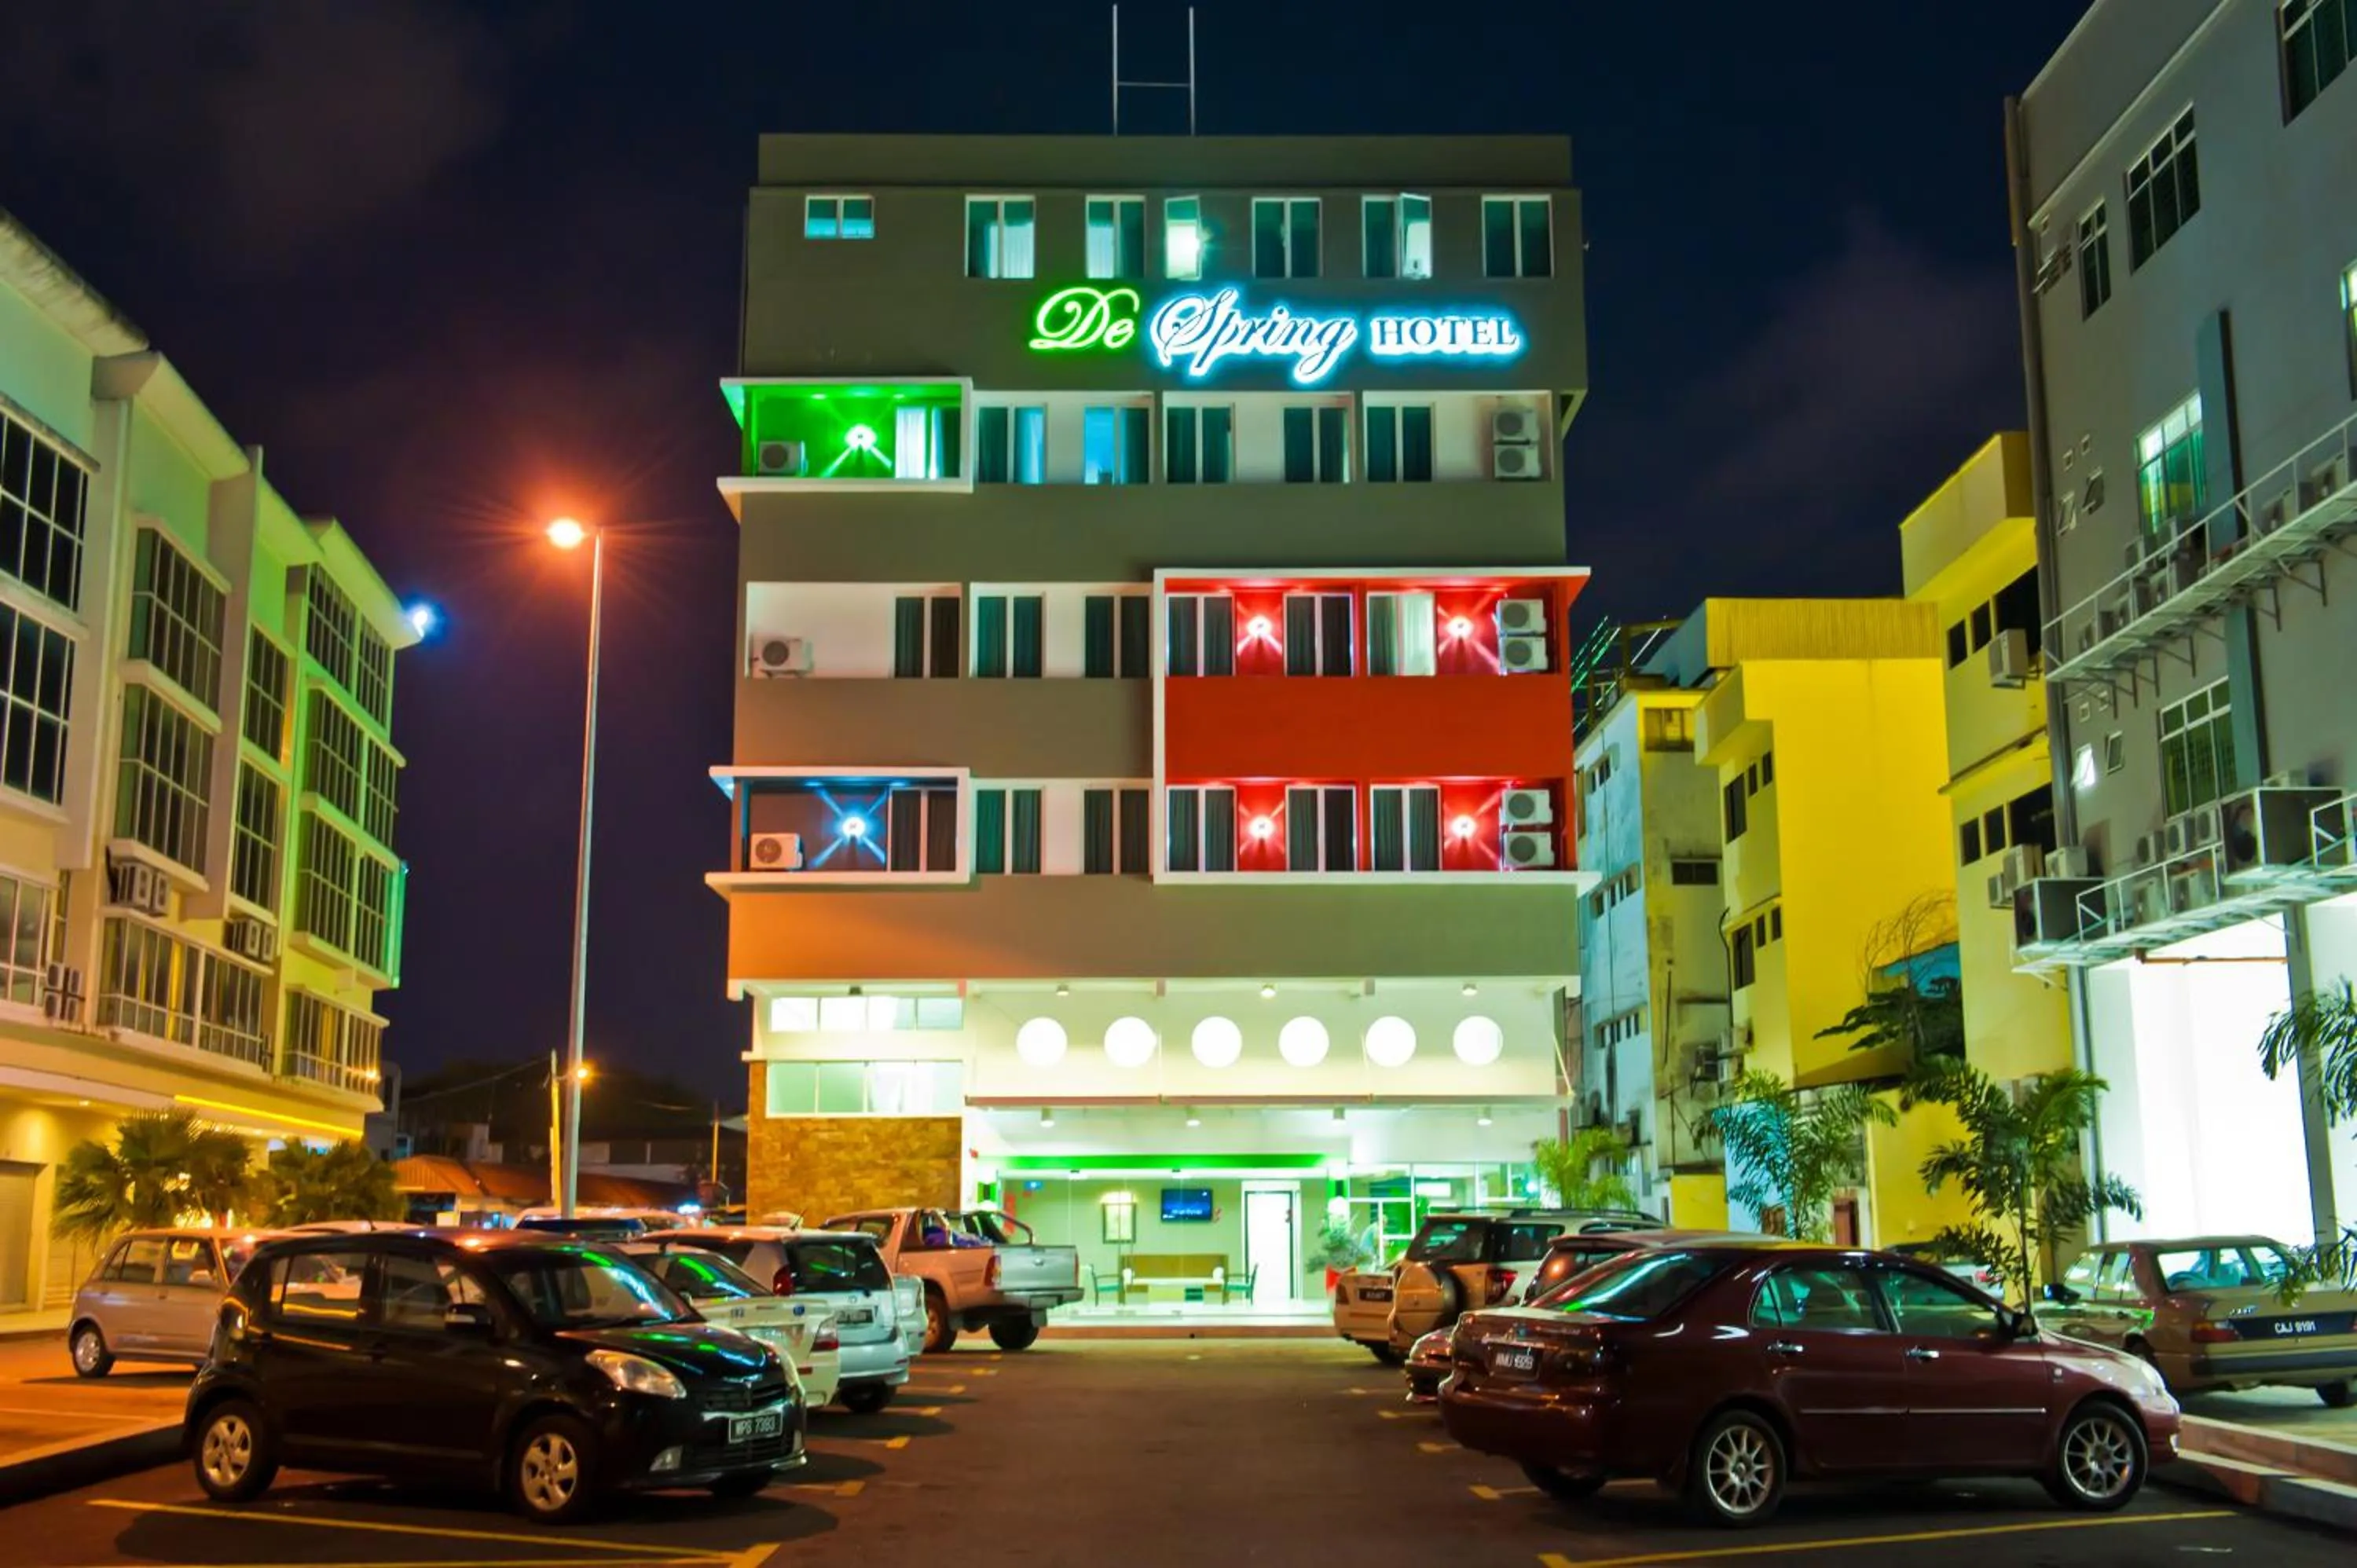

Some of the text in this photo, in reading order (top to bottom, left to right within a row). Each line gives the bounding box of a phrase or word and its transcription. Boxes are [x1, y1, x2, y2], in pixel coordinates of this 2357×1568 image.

[1030, 286, 1521, 382] De Spring HOTEL
